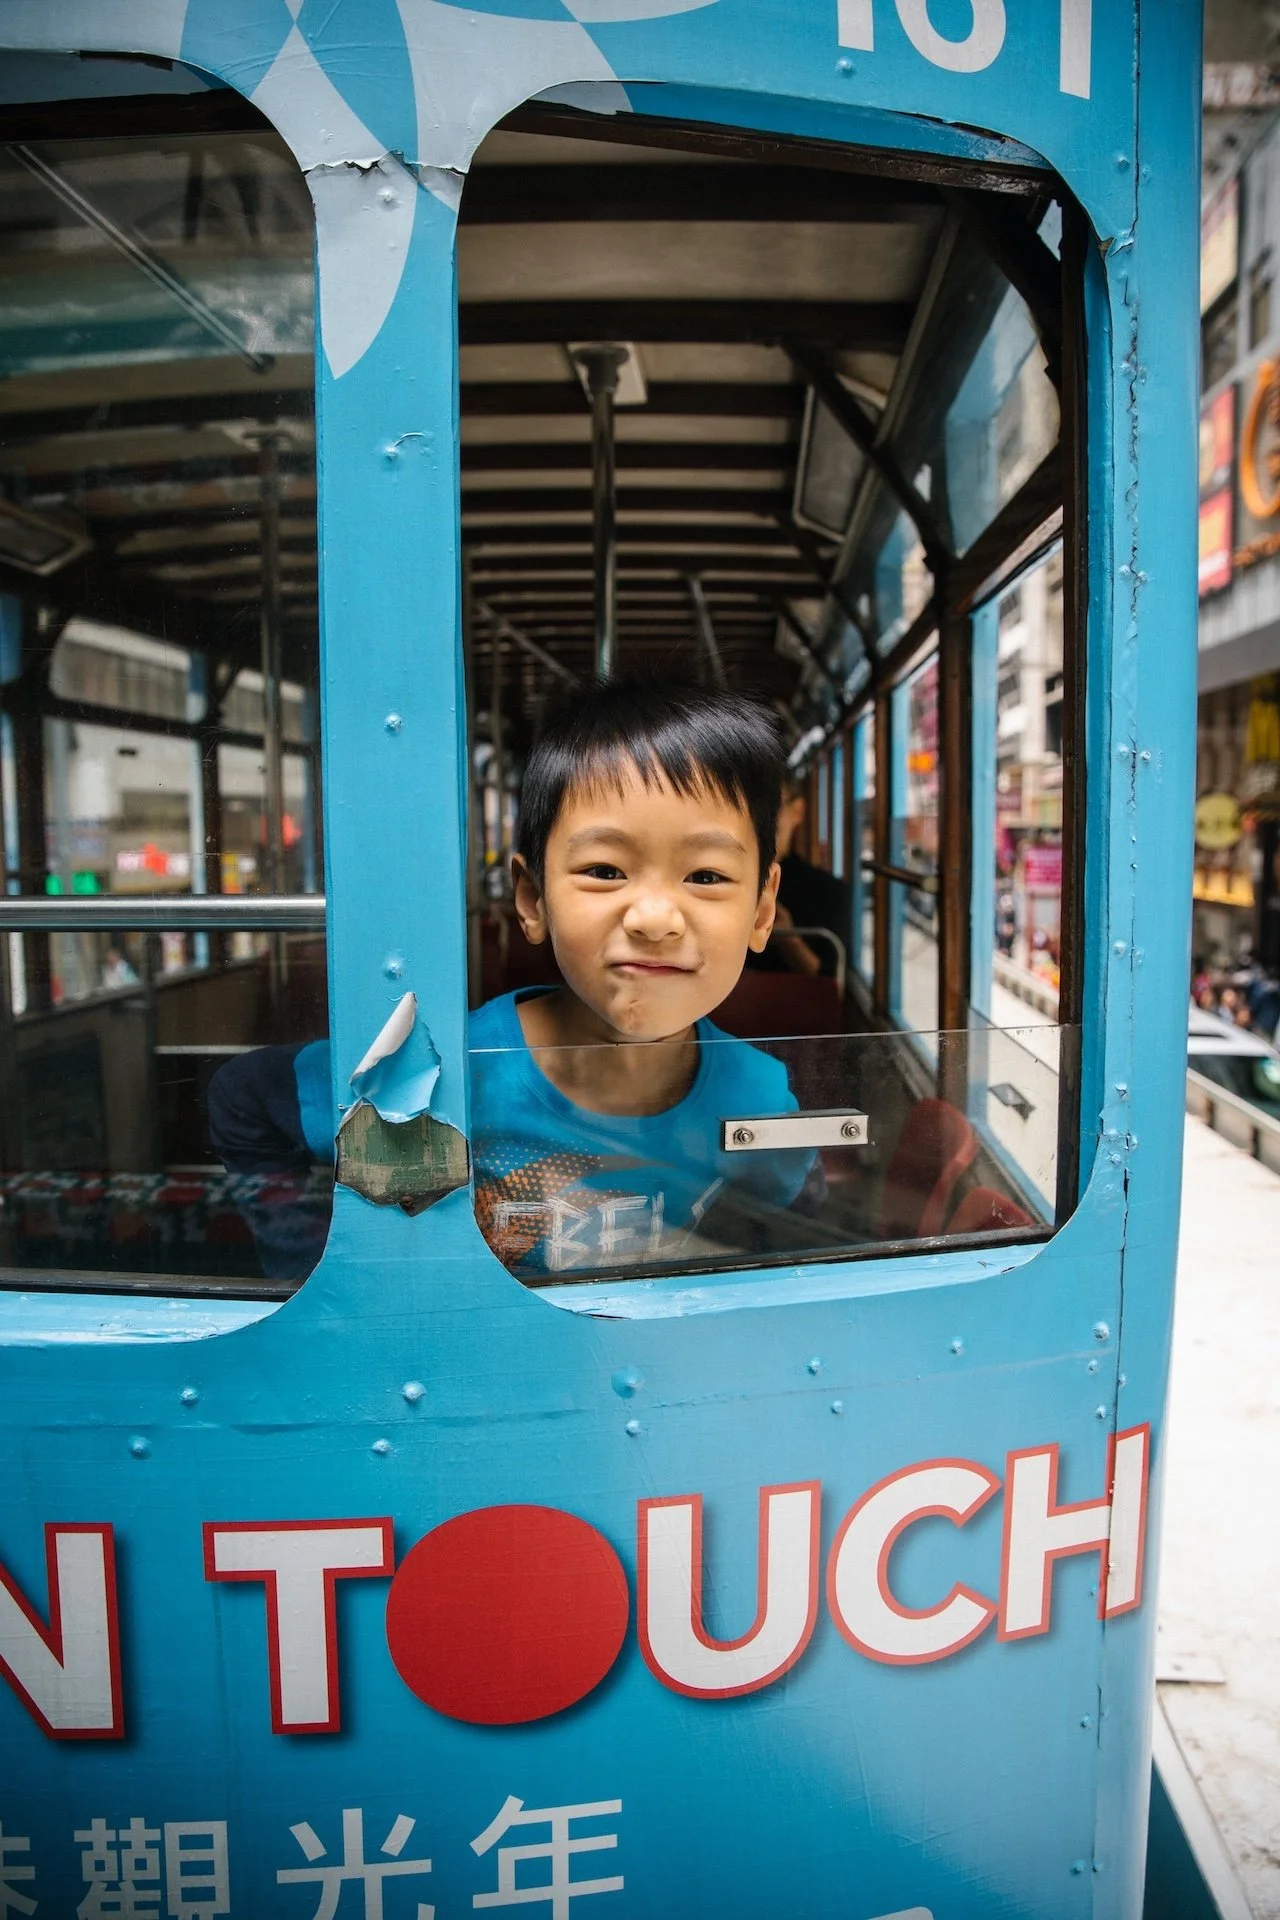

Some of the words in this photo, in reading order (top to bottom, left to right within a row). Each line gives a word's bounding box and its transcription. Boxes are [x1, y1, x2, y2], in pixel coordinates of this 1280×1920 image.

[0, 1522, 124, 1740] N
[202, 1421, 1151, 1735] TOUCH
[0, 1794, 624, 1920] 觀光年
